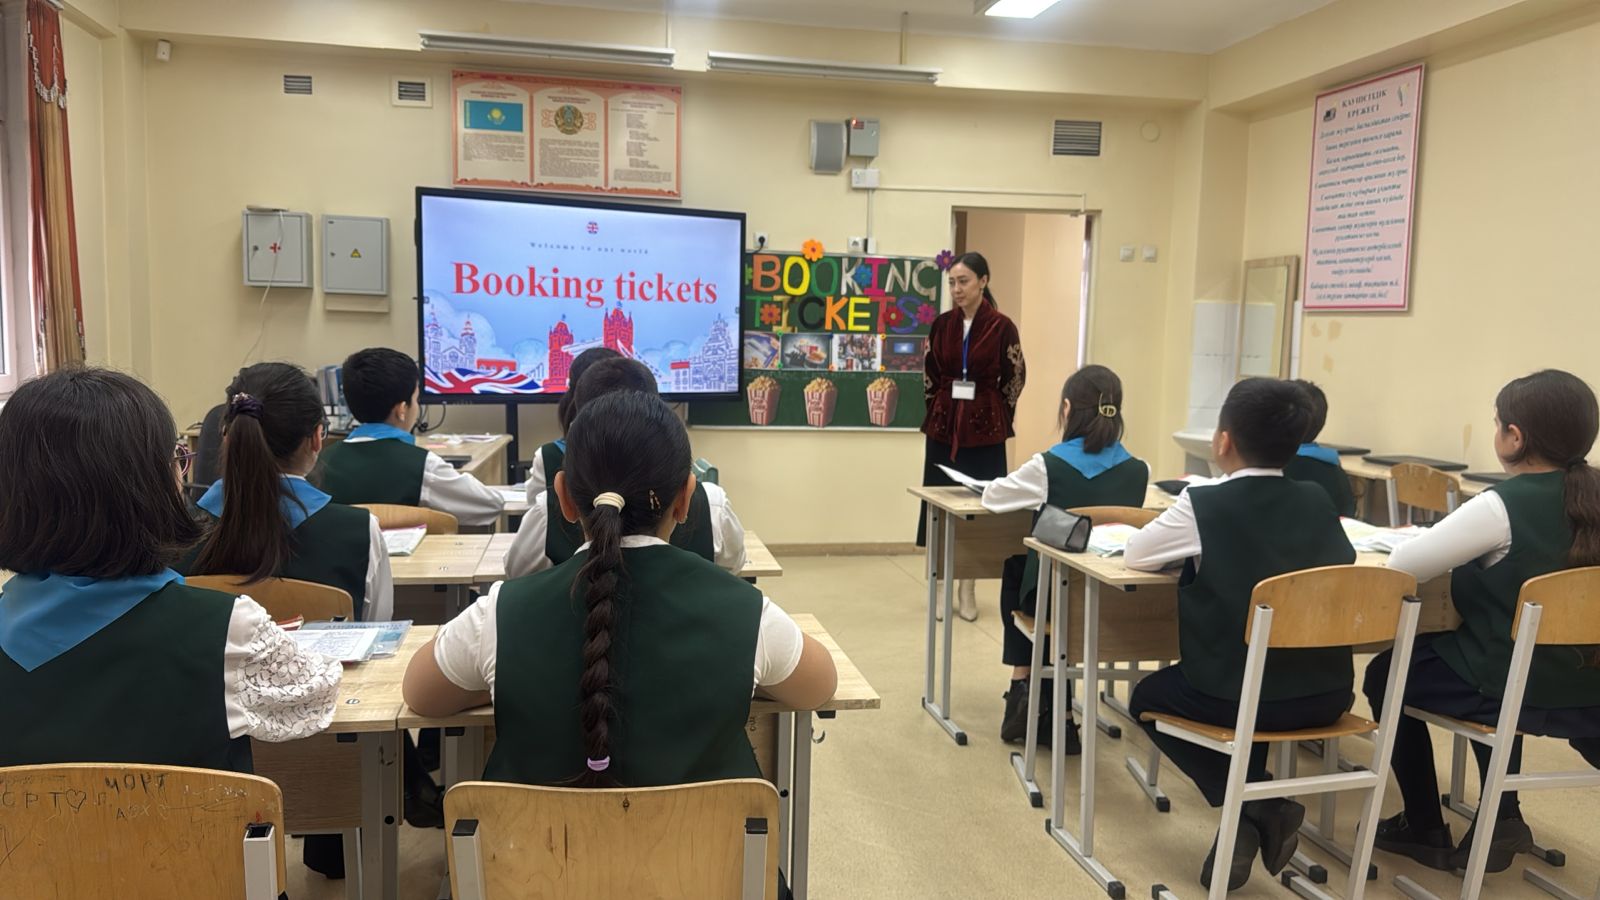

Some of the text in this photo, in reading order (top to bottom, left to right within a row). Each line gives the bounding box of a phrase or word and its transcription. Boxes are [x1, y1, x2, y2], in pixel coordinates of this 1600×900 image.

[530, 242, 574, 250] Welcome
[452, 261, 718, 309] Booking tickets
[752, 254, 939, 301] BOOKING
[745, 295, 923, 334] TICKETS
